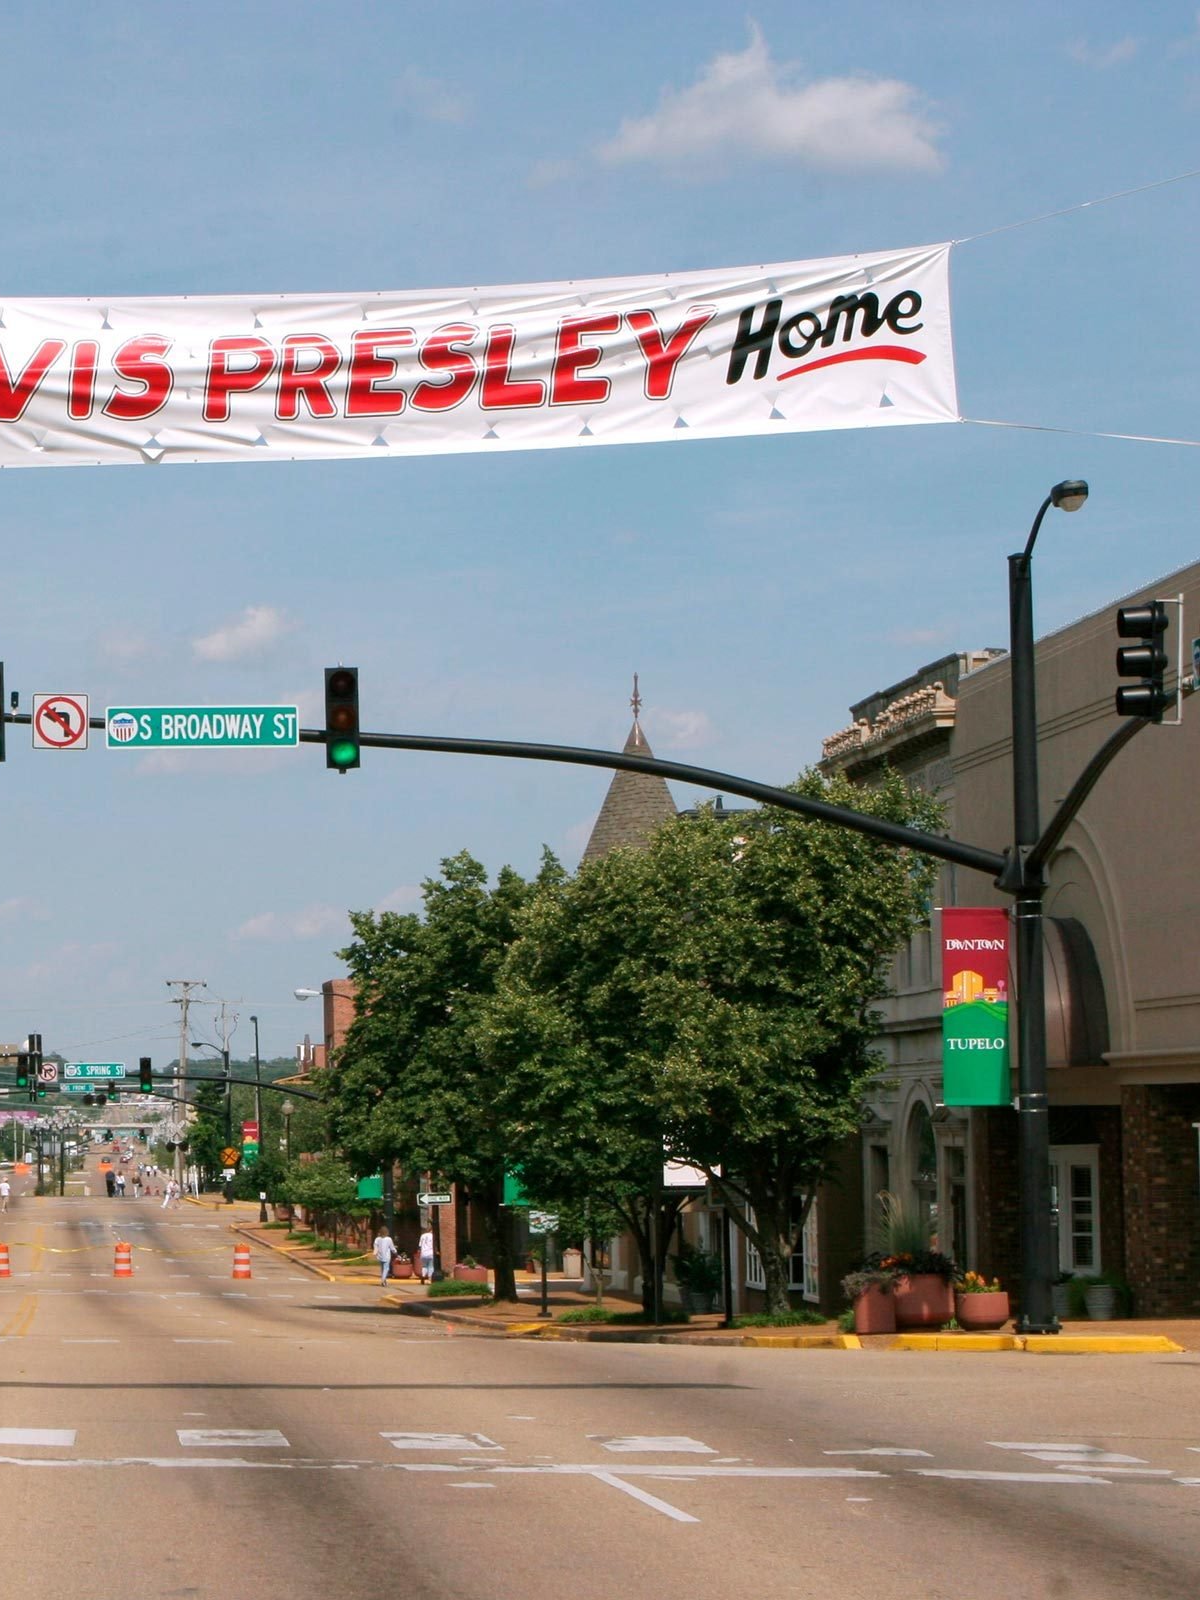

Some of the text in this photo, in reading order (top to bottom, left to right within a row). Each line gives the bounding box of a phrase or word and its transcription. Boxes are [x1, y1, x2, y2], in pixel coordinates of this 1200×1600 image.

[201, 303, 719, 423] PRESLEY
[725, 289, 924, 385] Home
[139, 713, 296, 740] S BROADWAY ST
[947, 1037, 1005, 1050] TUPELO
[77, 1066, 124, 1076] S SPRING ST
